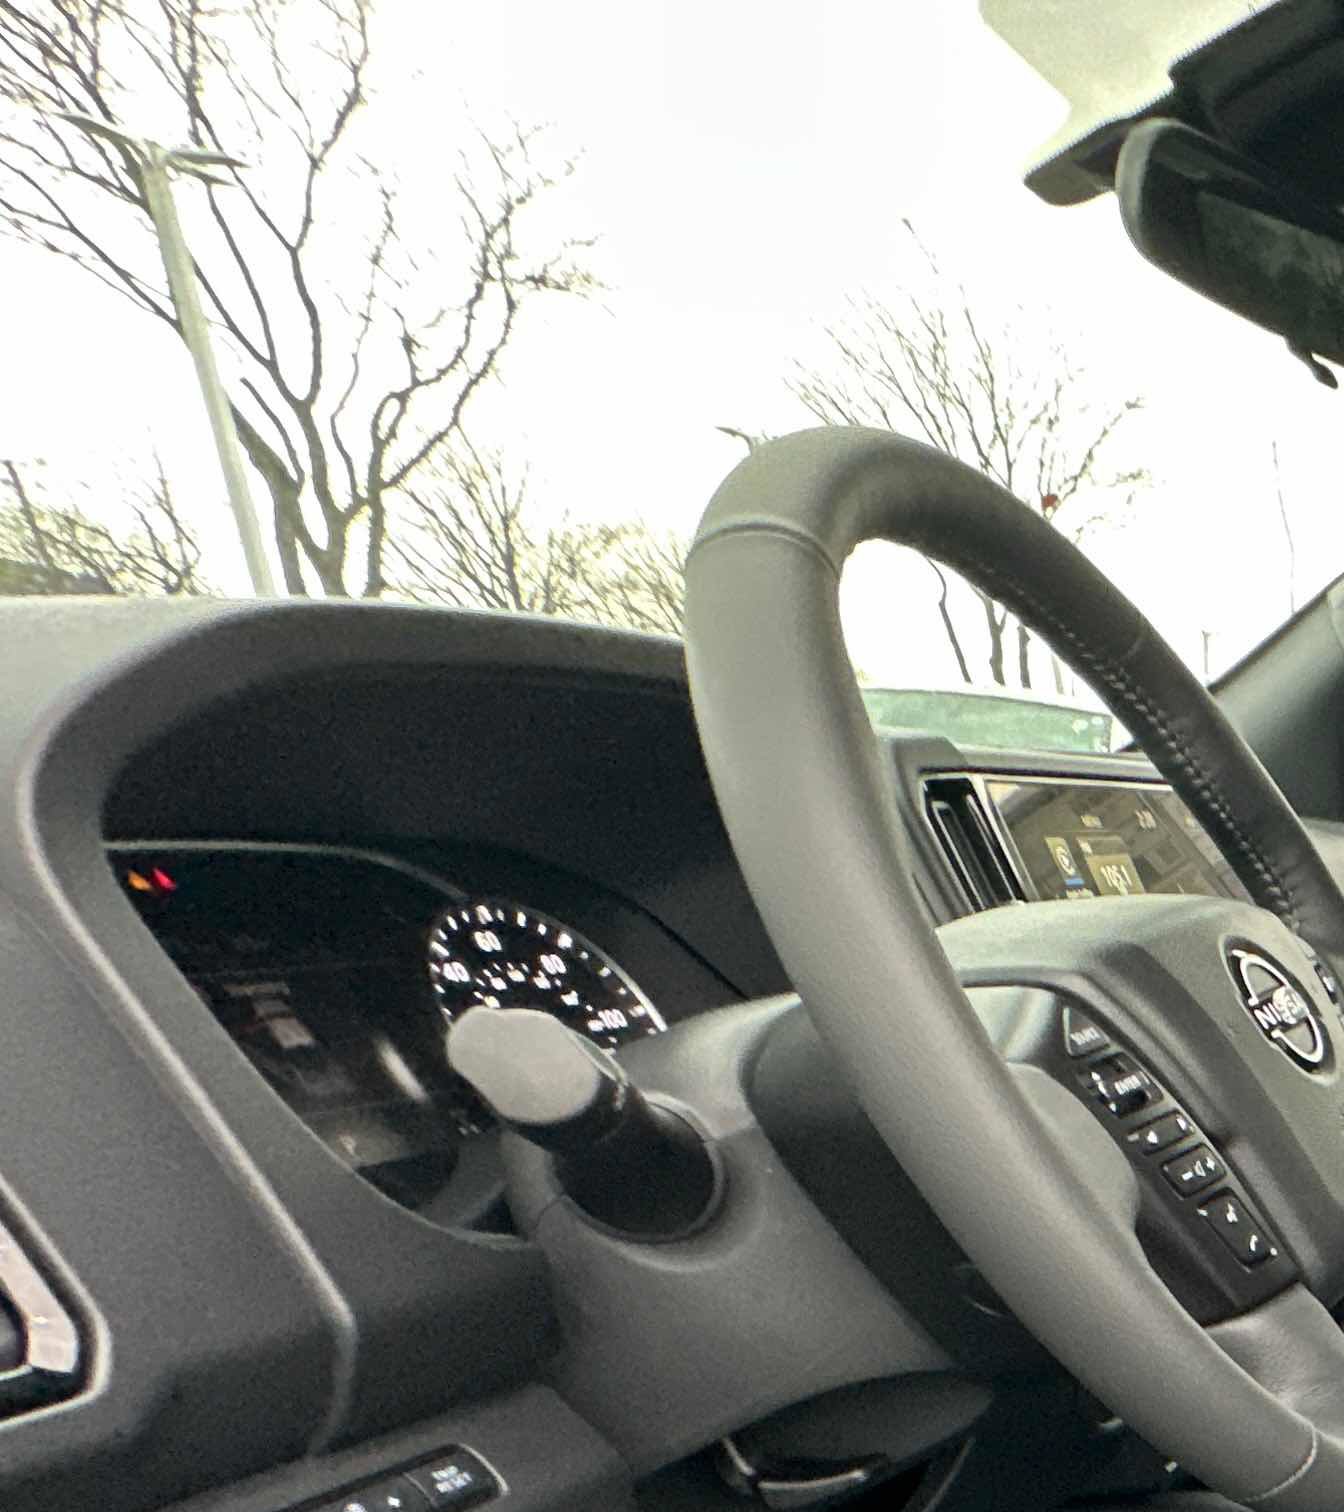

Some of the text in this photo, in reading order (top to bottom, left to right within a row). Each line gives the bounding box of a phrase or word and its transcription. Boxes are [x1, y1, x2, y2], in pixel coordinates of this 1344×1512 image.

[473, 930, 502, 952] 60
[442, 961, 471, 983] 40
[597, 1008, 629, 1029] 100
